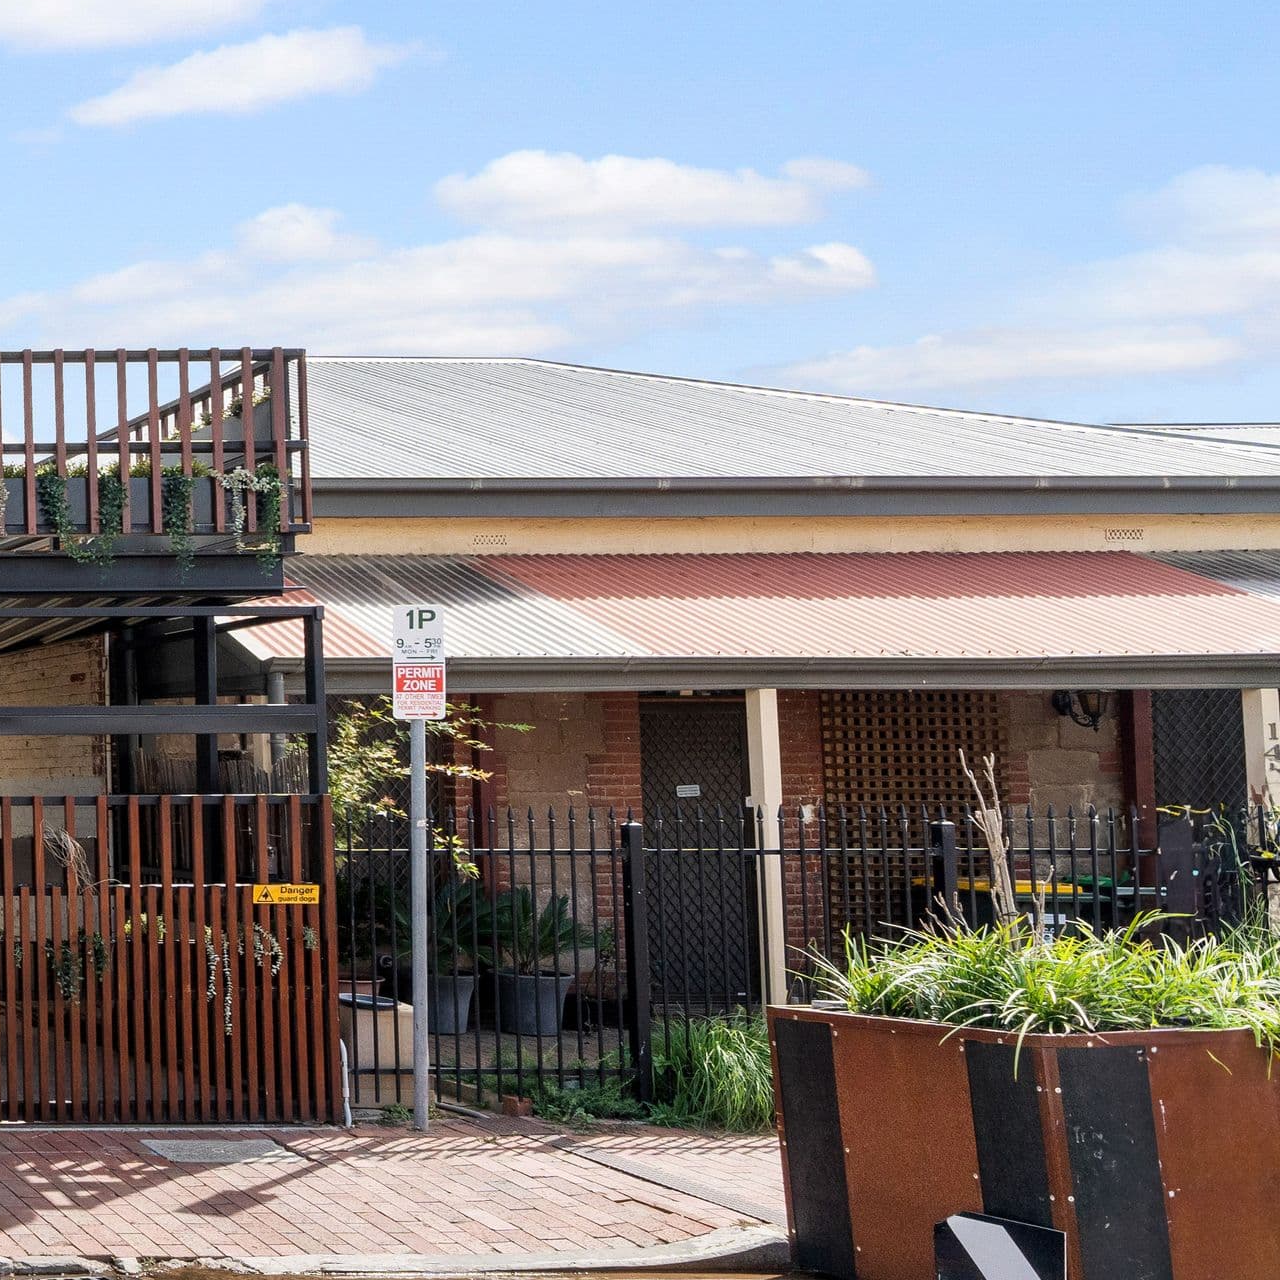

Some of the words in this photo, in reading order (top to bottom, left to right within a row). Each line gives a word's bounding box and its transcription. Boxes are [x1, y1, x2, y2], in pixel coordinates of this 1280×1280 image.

[406, 610, 436, 629] 1P
[398, 667, 441, 678] PERMIT
[403, 680, 436, 691] ZONE
[280, 886, 314, 895] Danger
